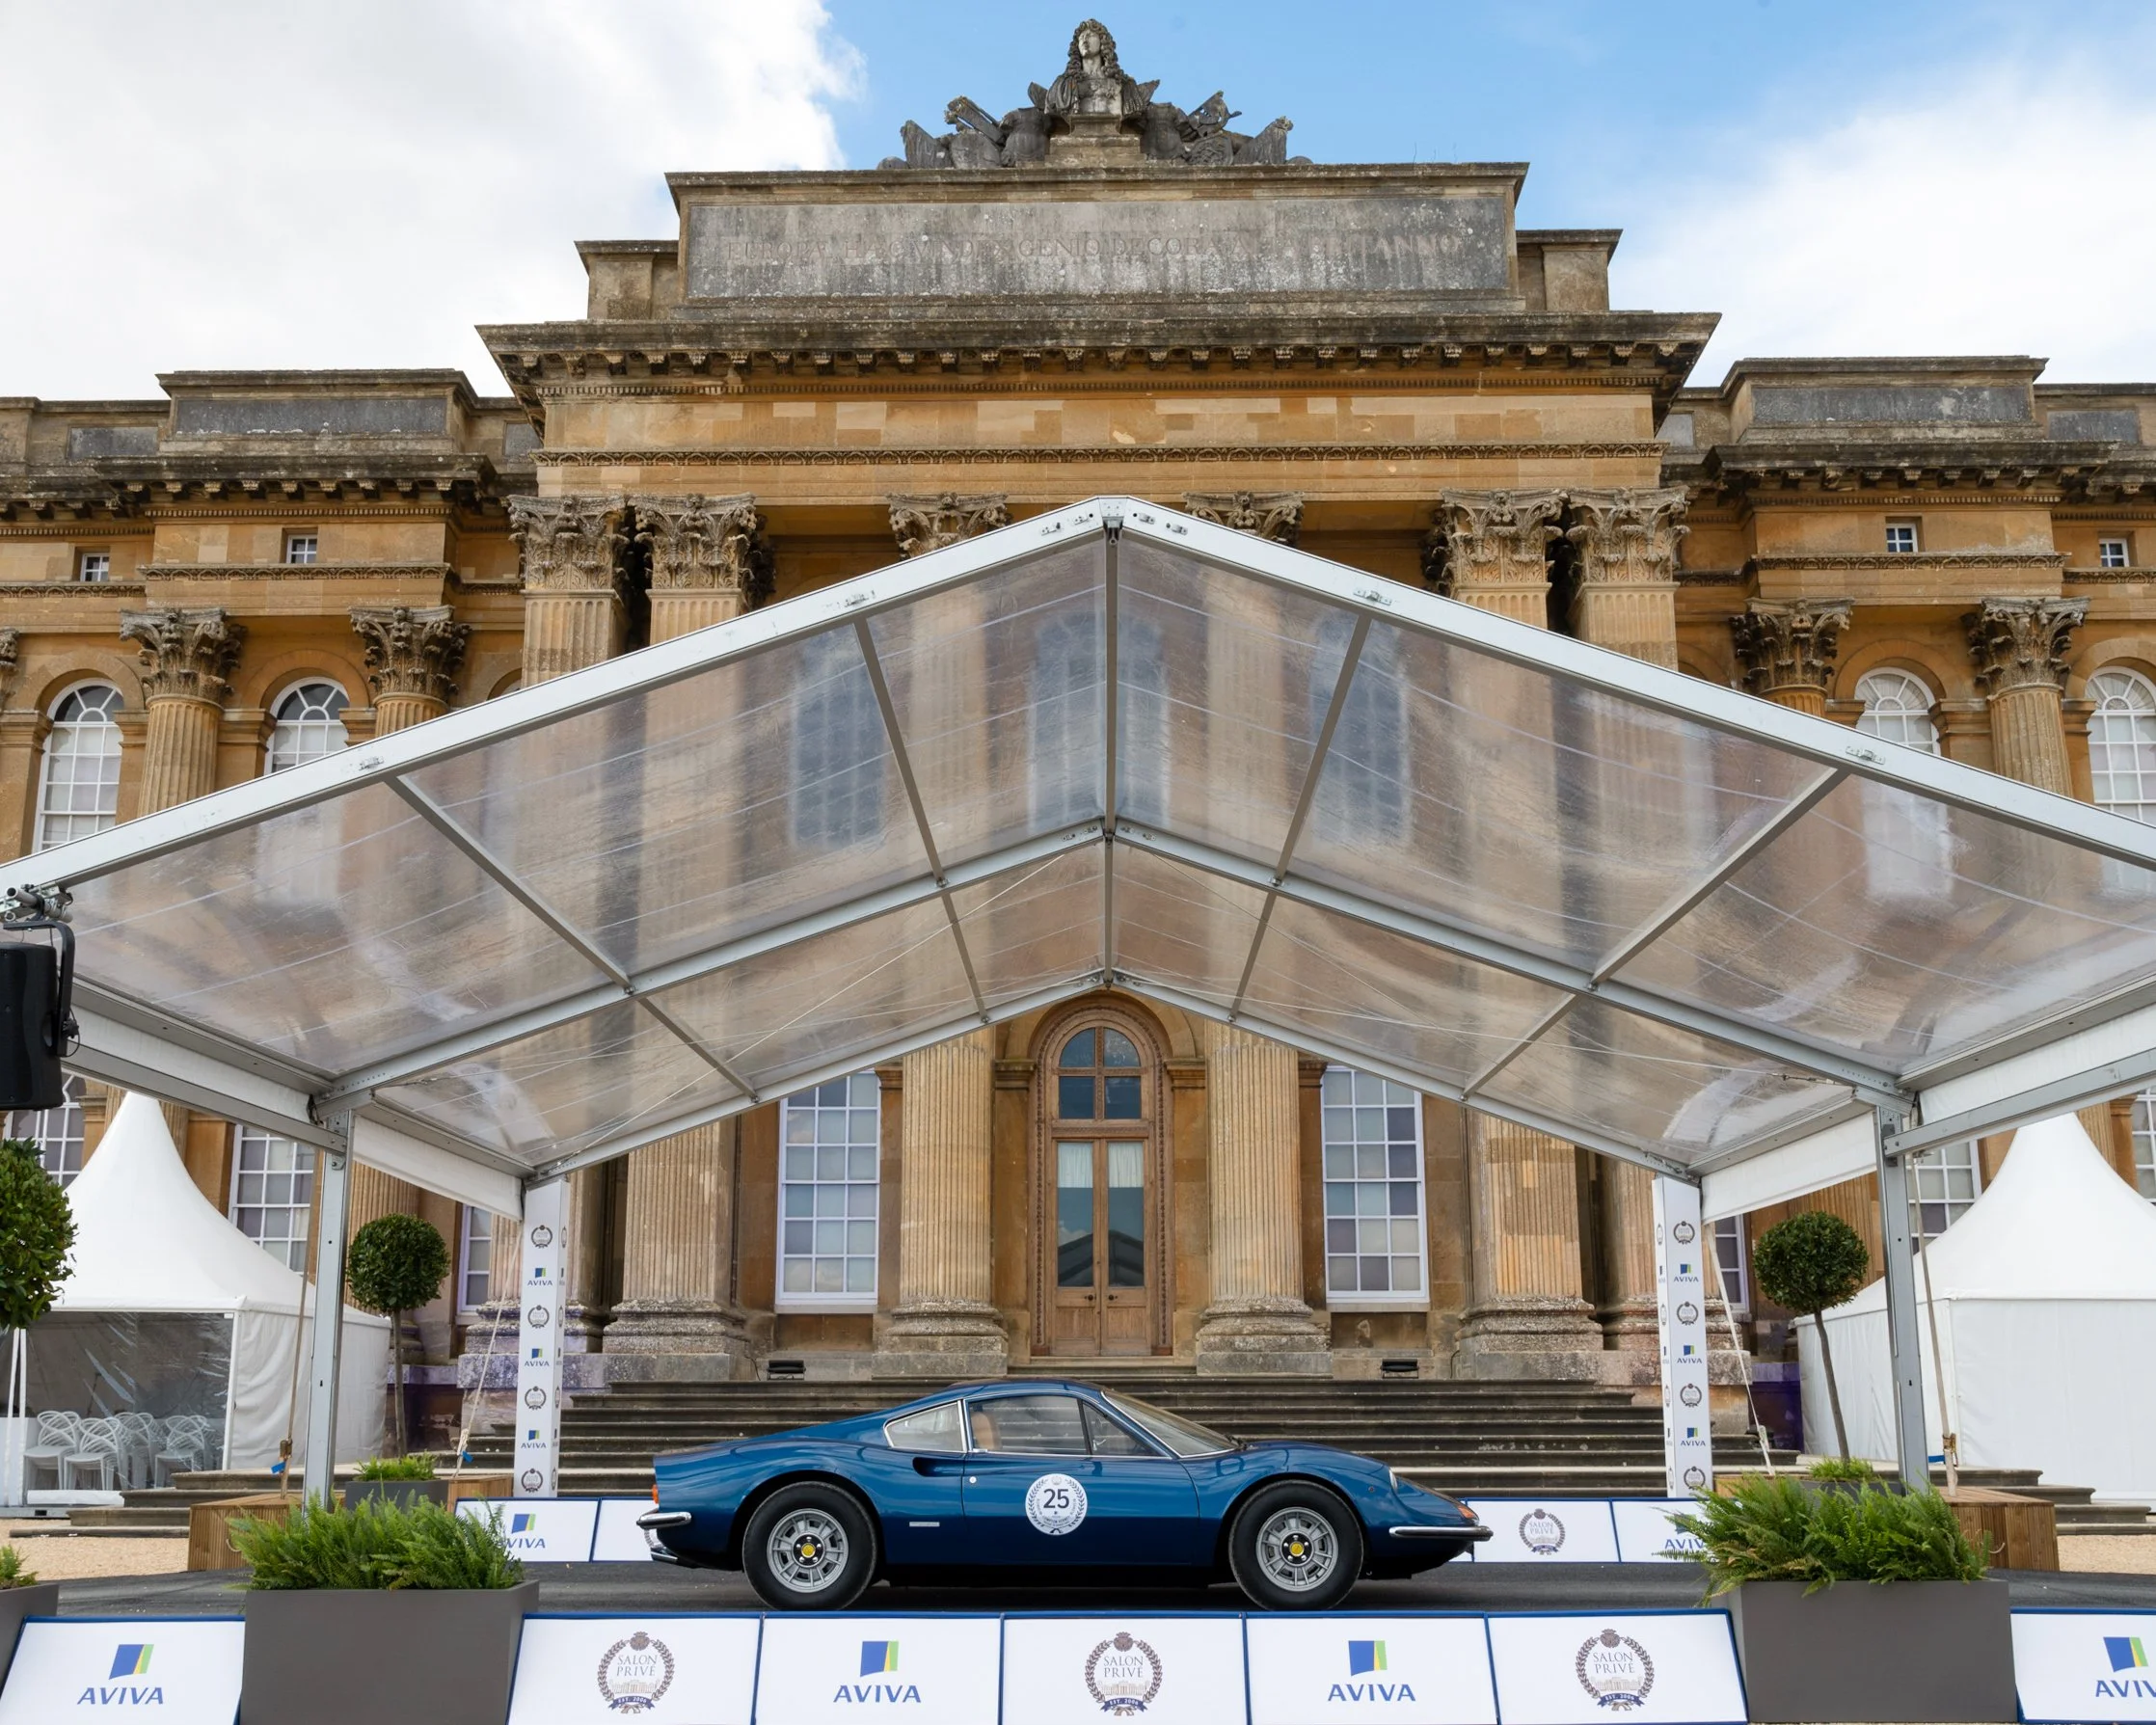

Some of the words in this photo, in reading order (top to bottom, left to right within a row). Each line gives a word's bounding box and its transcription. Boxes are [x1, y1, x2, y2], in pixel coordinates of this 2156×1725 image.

[1018, 239, 1100, 257] GENIO
[1112, 237, 1223, 256] DECORA
[1043, 1488, 1069, 1509] 25
[497, 1538, 546, 1549] VIVA
[1664, 1539, 1704, 1550] AVIV
[617, 1655, 658, 1665] SALON
[1103, 1656, 1144, 1666] SALON
[1593, 1652, 1633, 1662] SALON
[76, 1686, 164, 1705] AVIVA
[832, 1685, 922, 1703] AVIVA
[1327, 1684, 1416, 1702] AVIVA
[2095, 1680, 2156, 1698] AVIV
